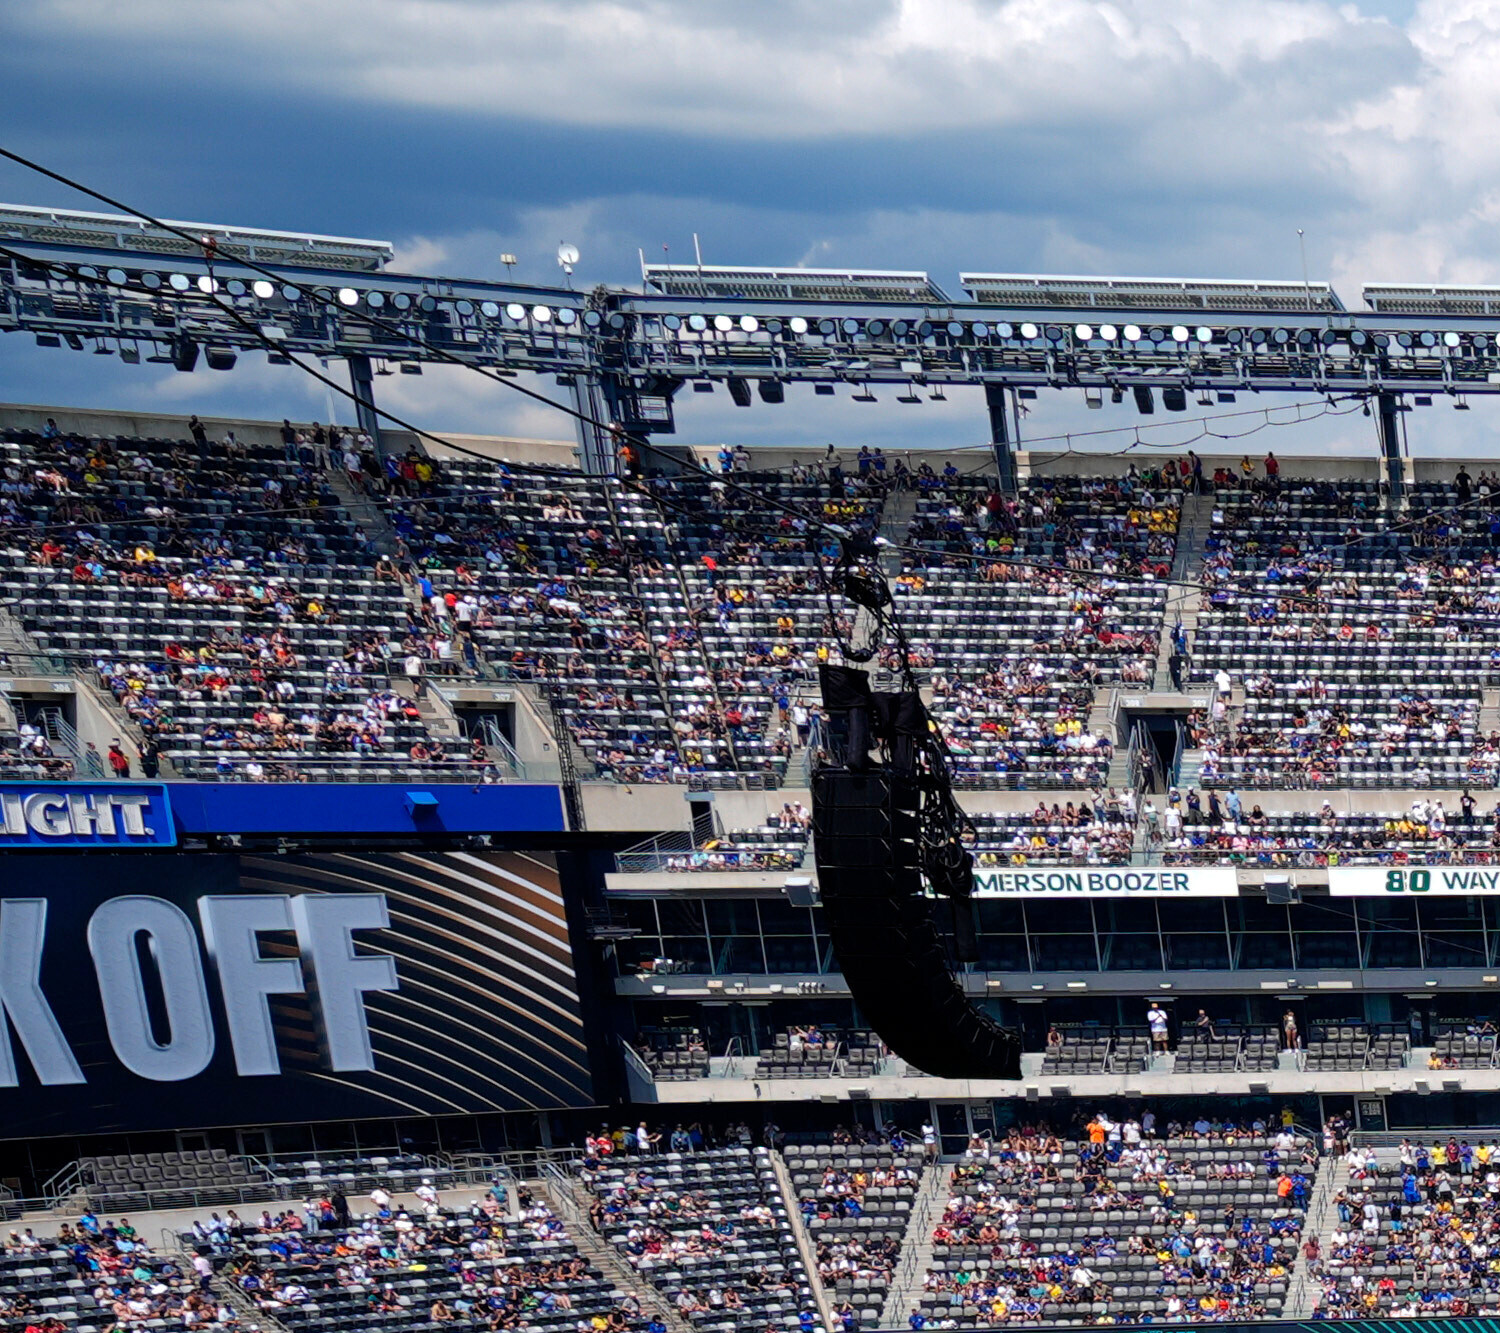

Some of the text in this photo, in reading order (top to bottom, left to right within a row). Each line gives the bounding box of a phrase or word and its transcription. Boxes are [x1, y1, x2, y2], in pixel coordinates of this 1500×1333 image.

[0, 793, 155, 836] IGHT.
[974, 873, 1190, 892] MERSON BOOZER
[1386, 869, 1431, 893] 80
[87, 893, 399, 1083] OFF
